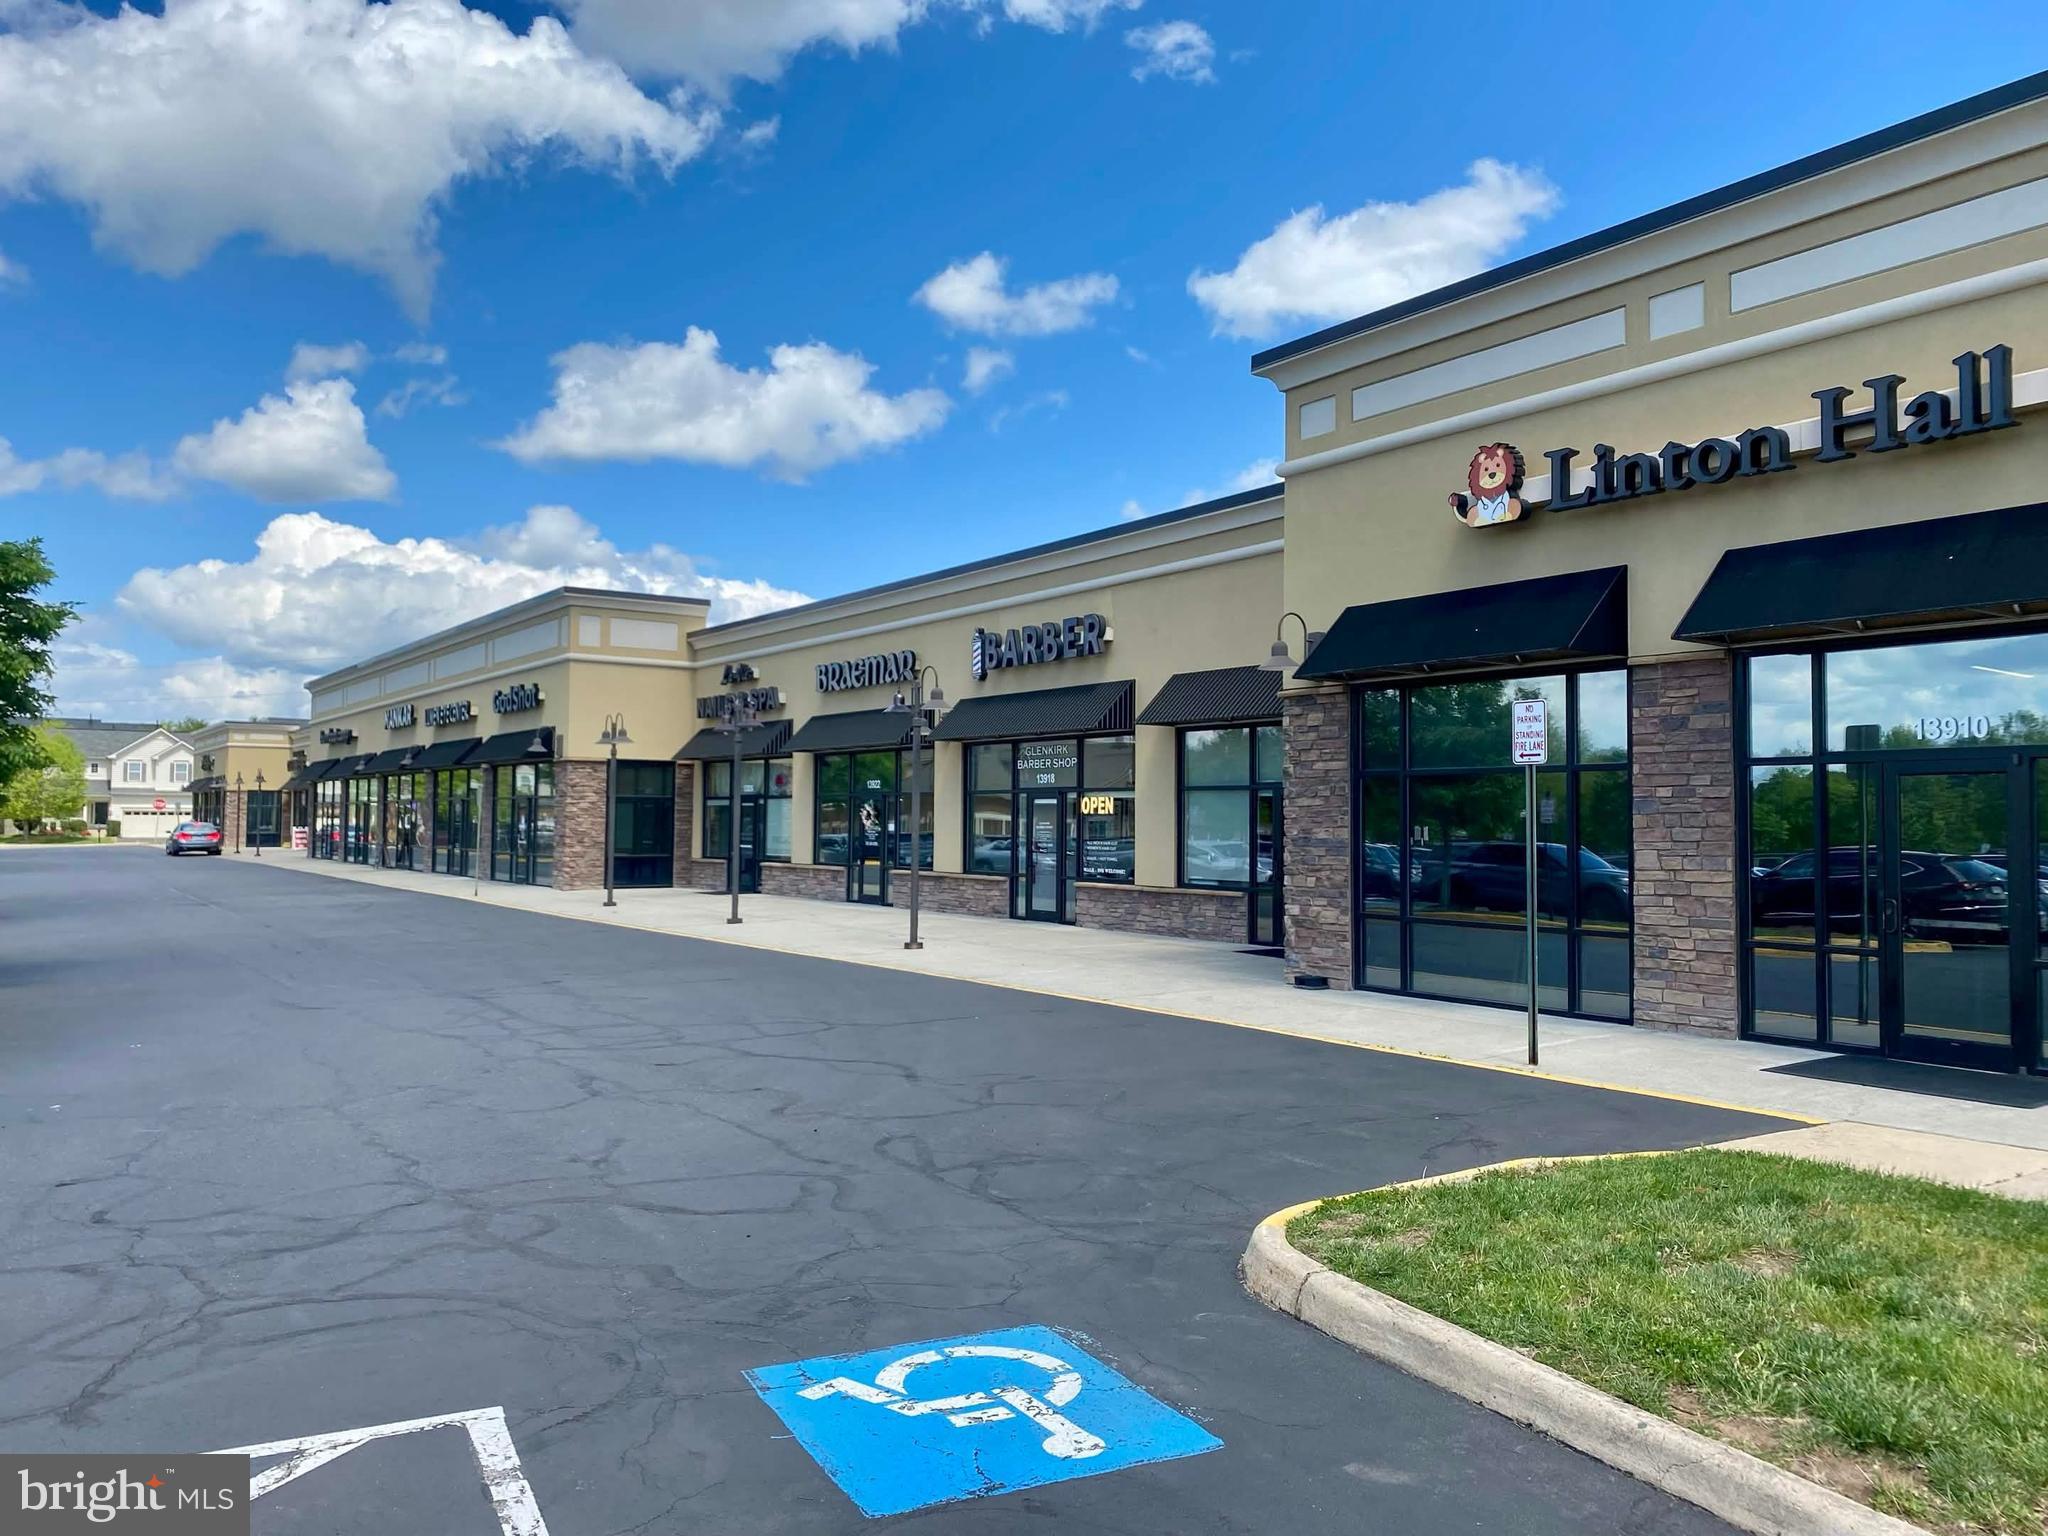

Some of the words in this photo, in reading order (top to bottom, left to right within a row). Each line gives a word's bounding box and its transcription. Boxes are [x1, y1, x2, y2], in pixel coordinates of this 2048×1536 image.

[1542, 424, 1797, 513] Linton
[1811, 343, 2022, 463] Hall
[984, 613, 1107, 671] BARBER
[815, 650, 917, 694] BRAEMAR
[750, 686, 780, 712] SPA
[1525, 705, 1534, 713] NO
[1516, 715, 1542, 725] PARKING
[1914, 715, 1991, 741] 13910
[1515, 730, 1544, 740] STANDING
[1025, 745, 1069, 756] GLENKIRK
[1515, 741, 1528, 752] FIRE
[1528, 740, 1545, 751] LANE
[1017, 758, 1052, 770] BARBER
[1052, 757, 1078, 768] SHOP
[1036, 773, 1056, 784] 13918
[1081, 796, 1115, 815] OPEN
